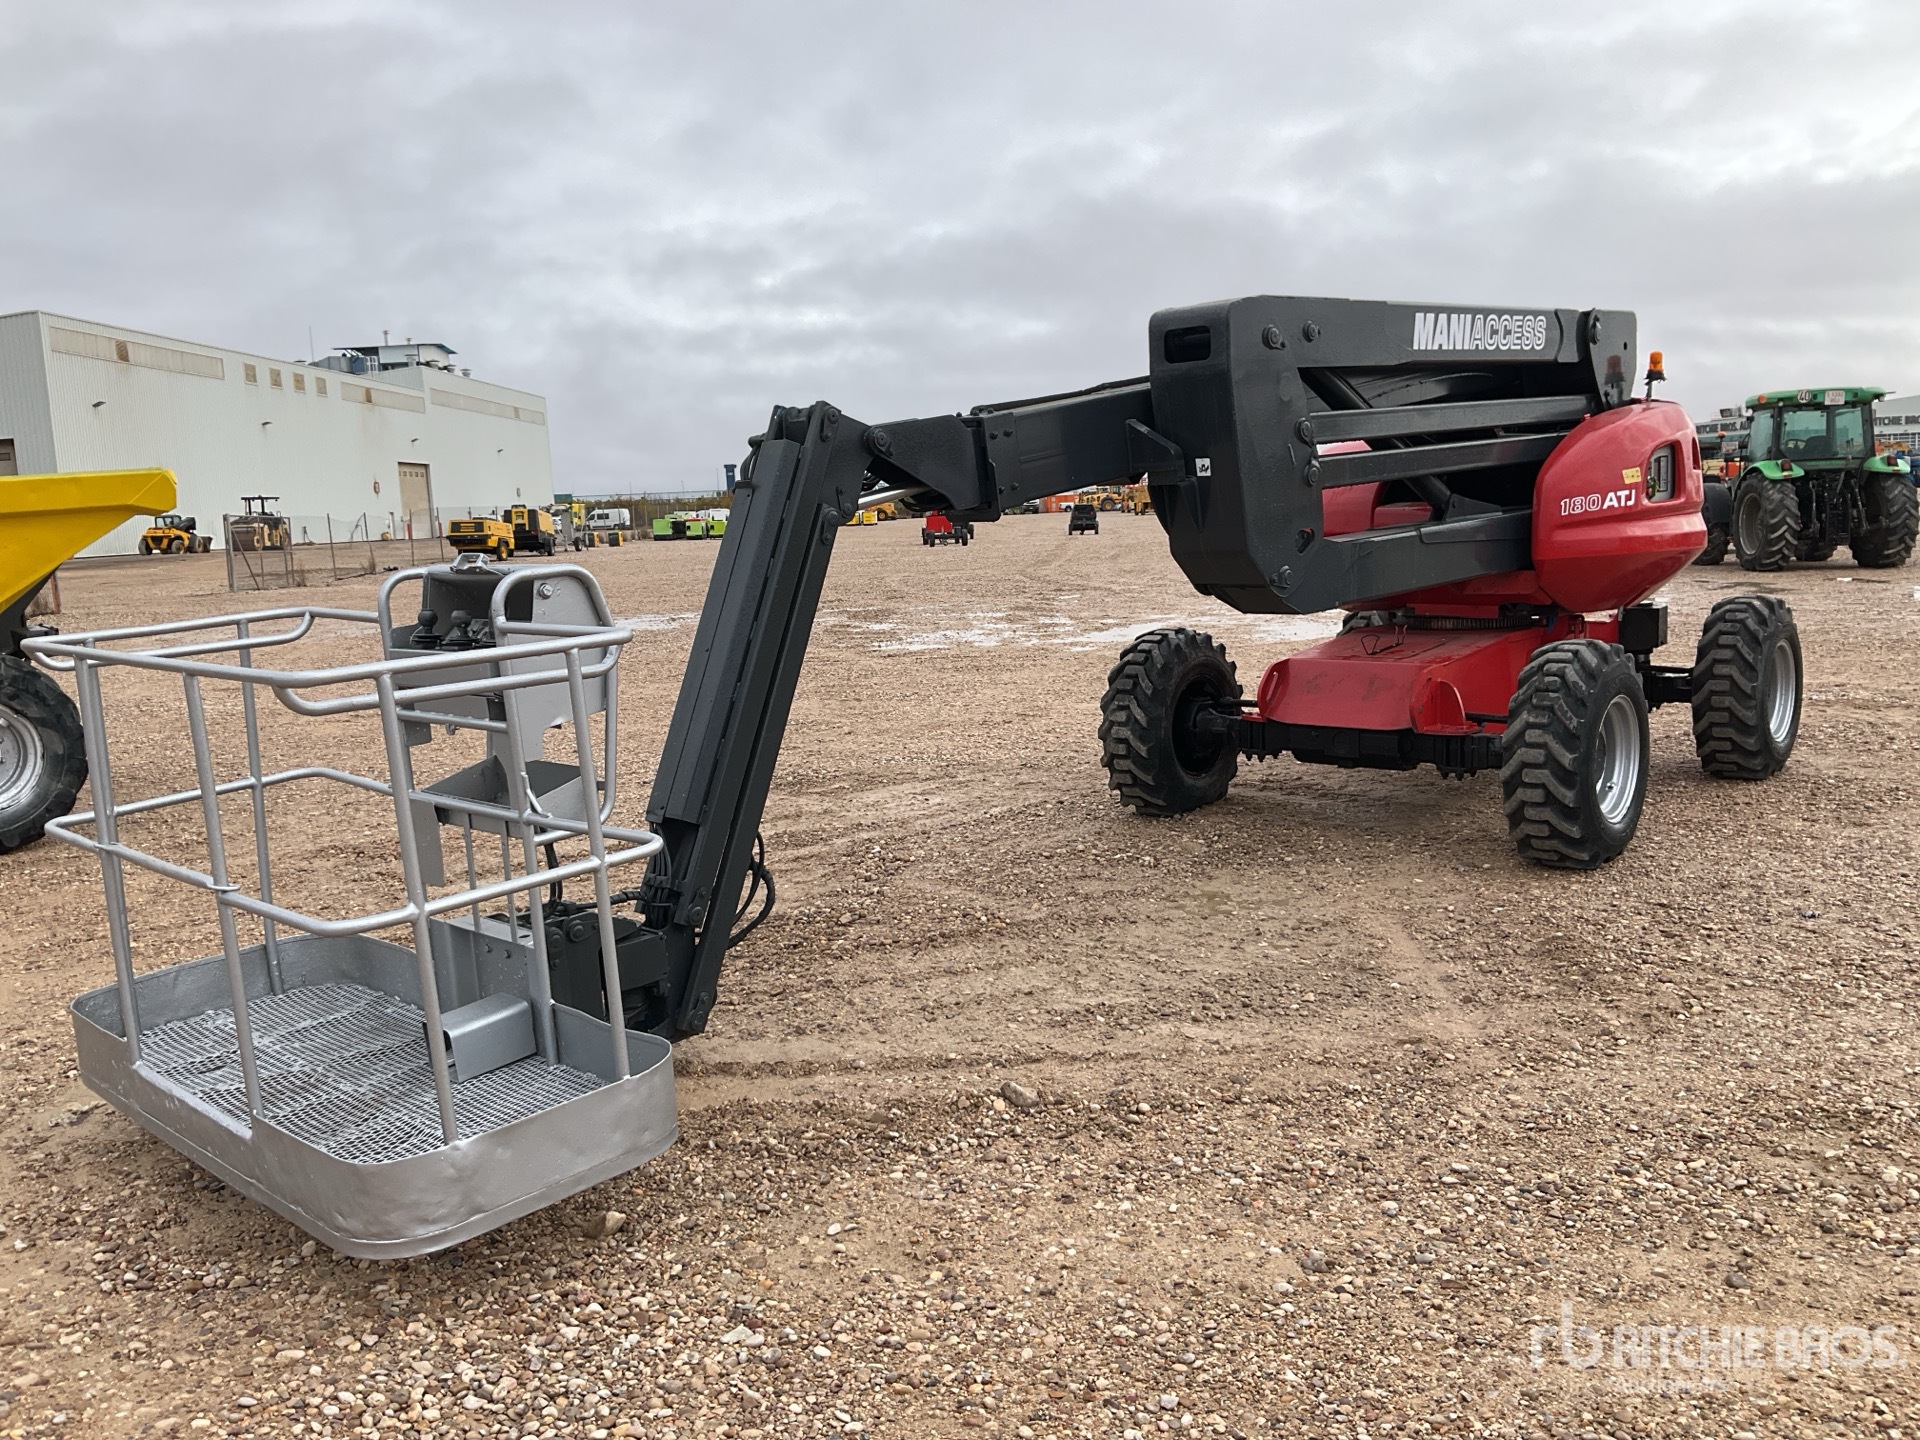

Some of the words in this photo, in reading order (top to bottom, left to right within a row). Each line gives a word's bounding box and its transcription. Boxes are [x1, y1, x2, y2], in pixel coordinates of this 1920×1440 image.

[1413, 312, 1546, 350] MANIACCESS
[1799, 390, 1810, 401] 40
[1560, 494, 1601, 516] 180
[1602, 489, 1636, 510] ATJ
